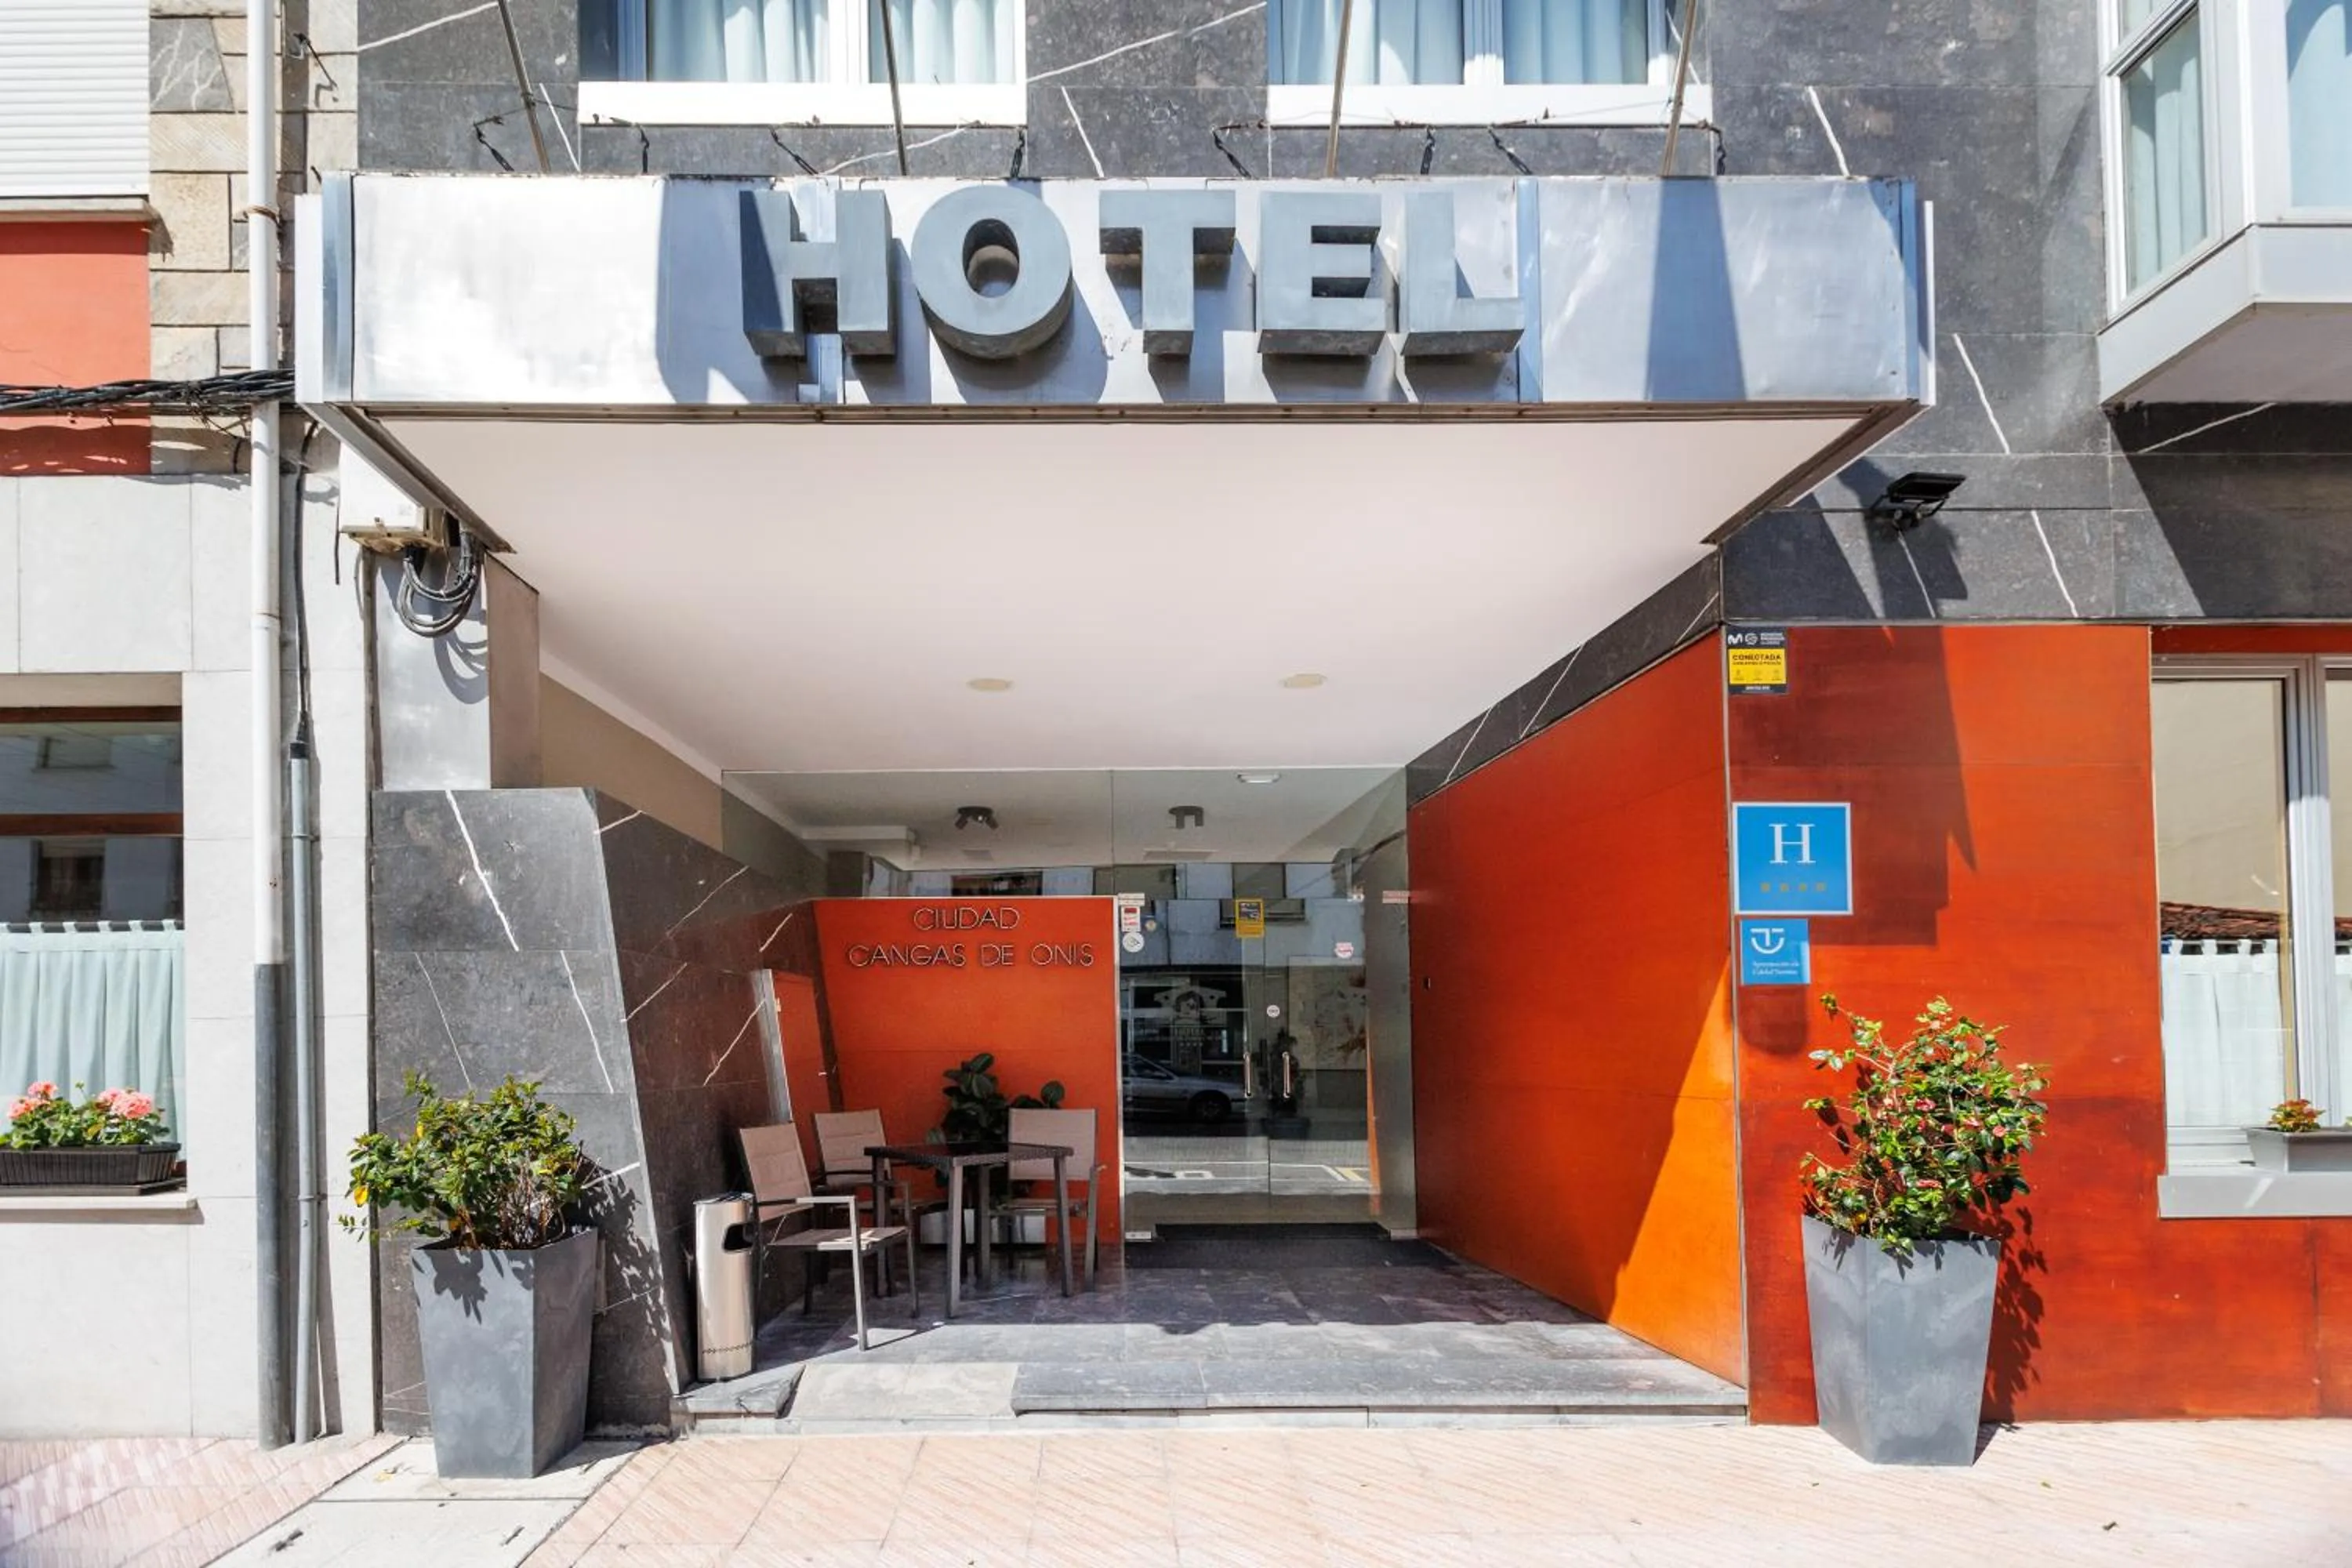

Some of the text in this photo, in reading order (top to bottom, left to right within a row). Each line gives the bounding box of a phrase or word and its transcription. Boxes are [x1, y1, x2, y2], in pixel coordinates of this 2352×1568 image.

[739, 184, 1525, 357] HOTEL
[1768, 823, 1817, 864] H
[913, 907, 1020, 931] CIUDAD
[849, 943, 1095, 967] CANGAS DE ONIS
